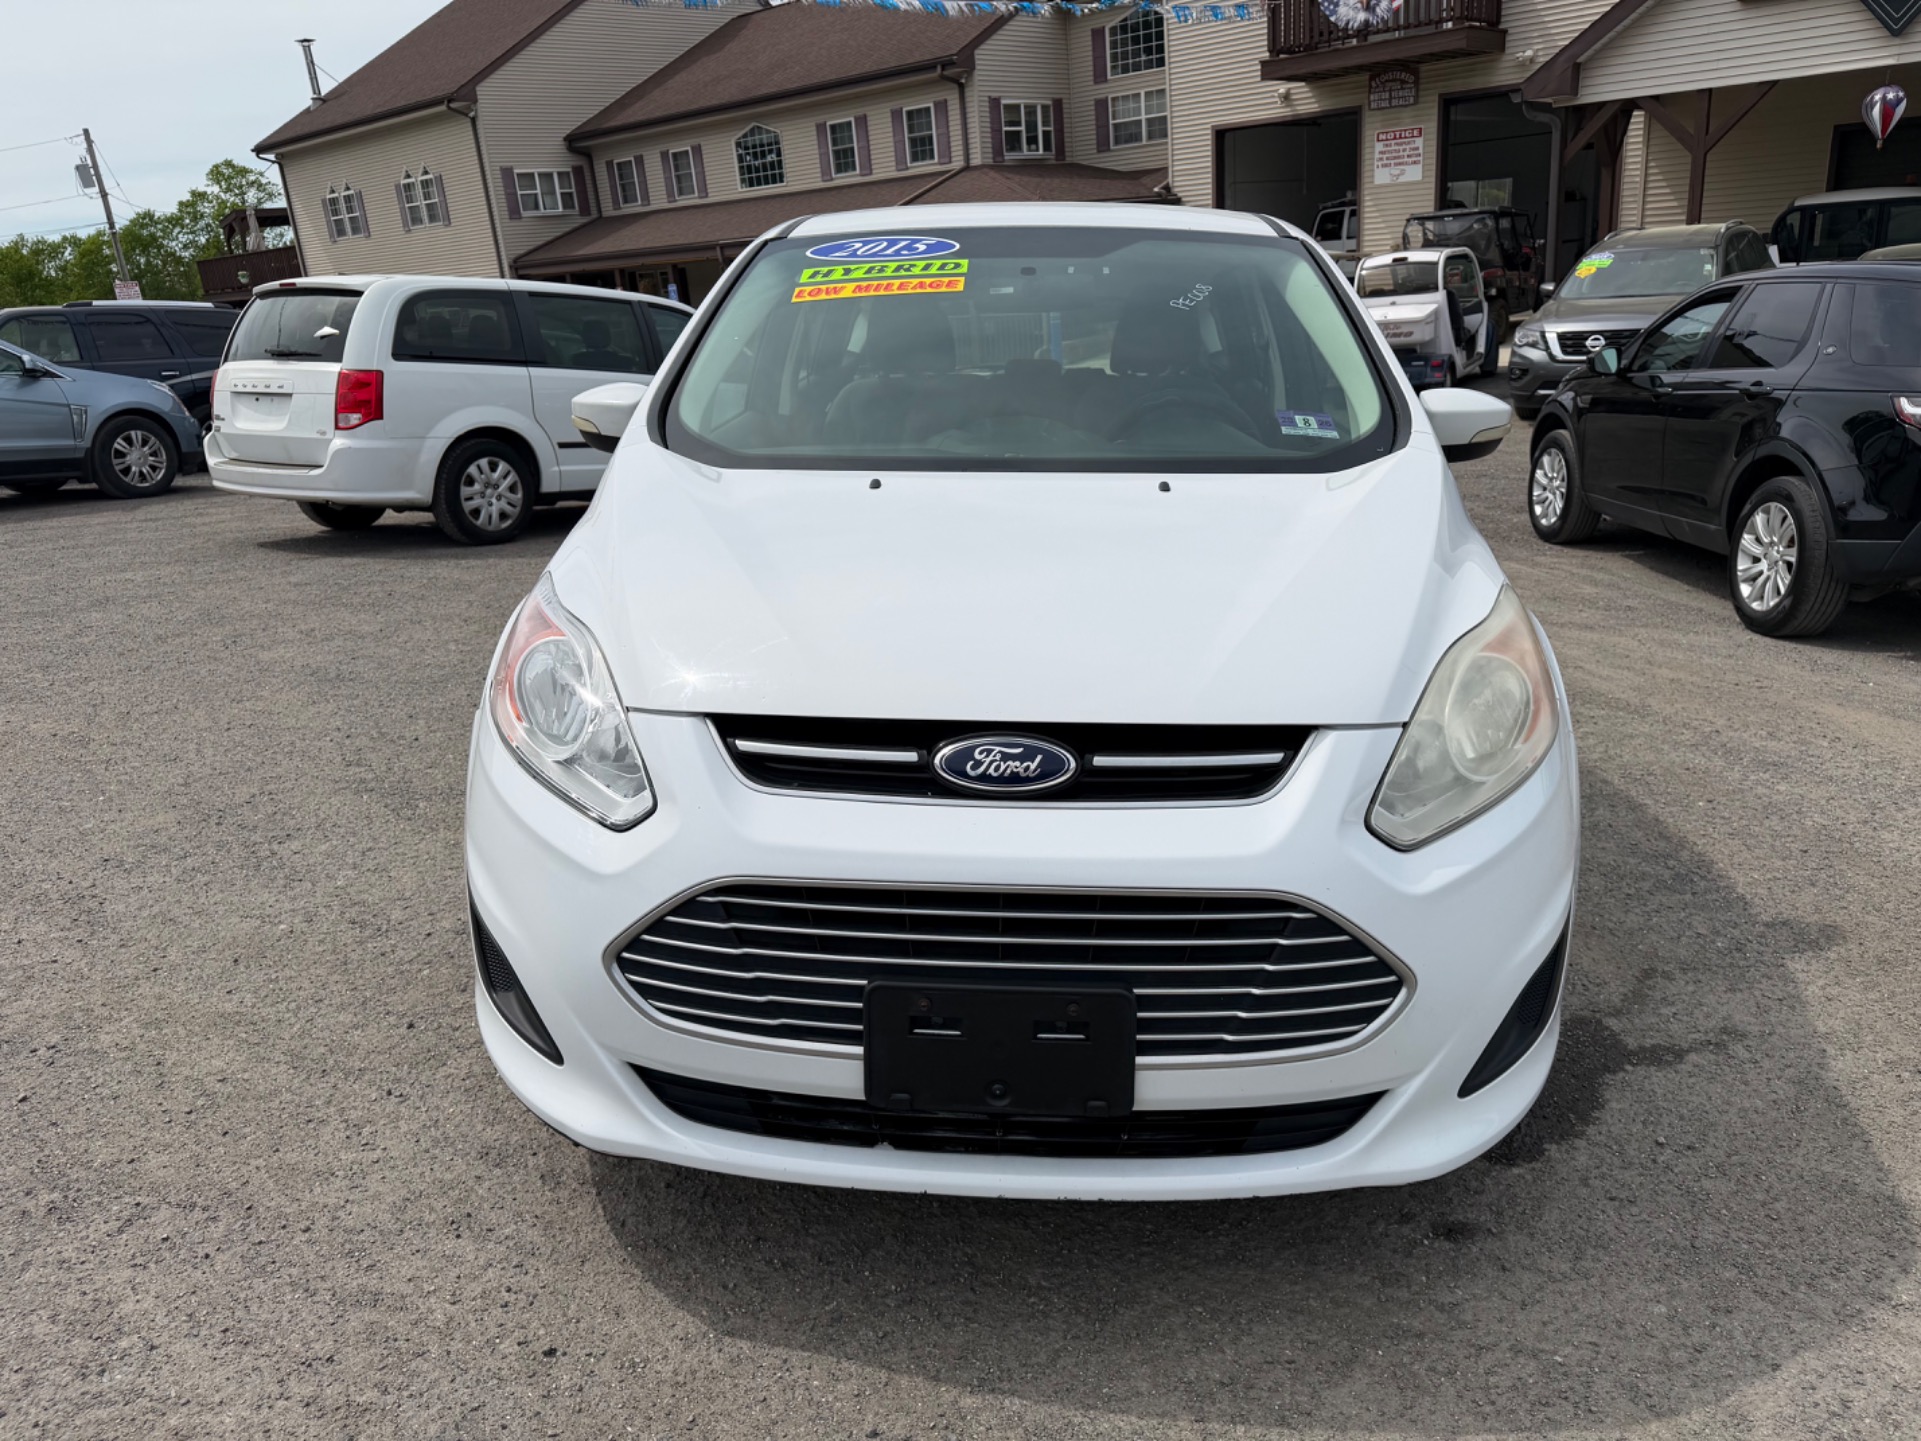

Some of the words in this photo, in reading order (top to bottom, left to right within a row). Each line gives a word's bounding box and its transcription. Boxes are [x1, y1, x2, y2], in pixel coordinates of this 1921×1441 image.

[1371, 71, 1415, 88] REGISTERED
[1391, 88, 1415, 98] VEHICLE
[1391, 96, 1415, 106] DEALER
[1378, 129, 1420, 140] NOTICE
[829, 239, 936, 258] 2015
[807, 261, 963, 280] HYBRID
[794, 284, 846, 300] LOW
[851, 279, 961, 295] MILEAGE
[1302, 417, 1311, 427] 8
[965, 745, 1044, 777] Ford
